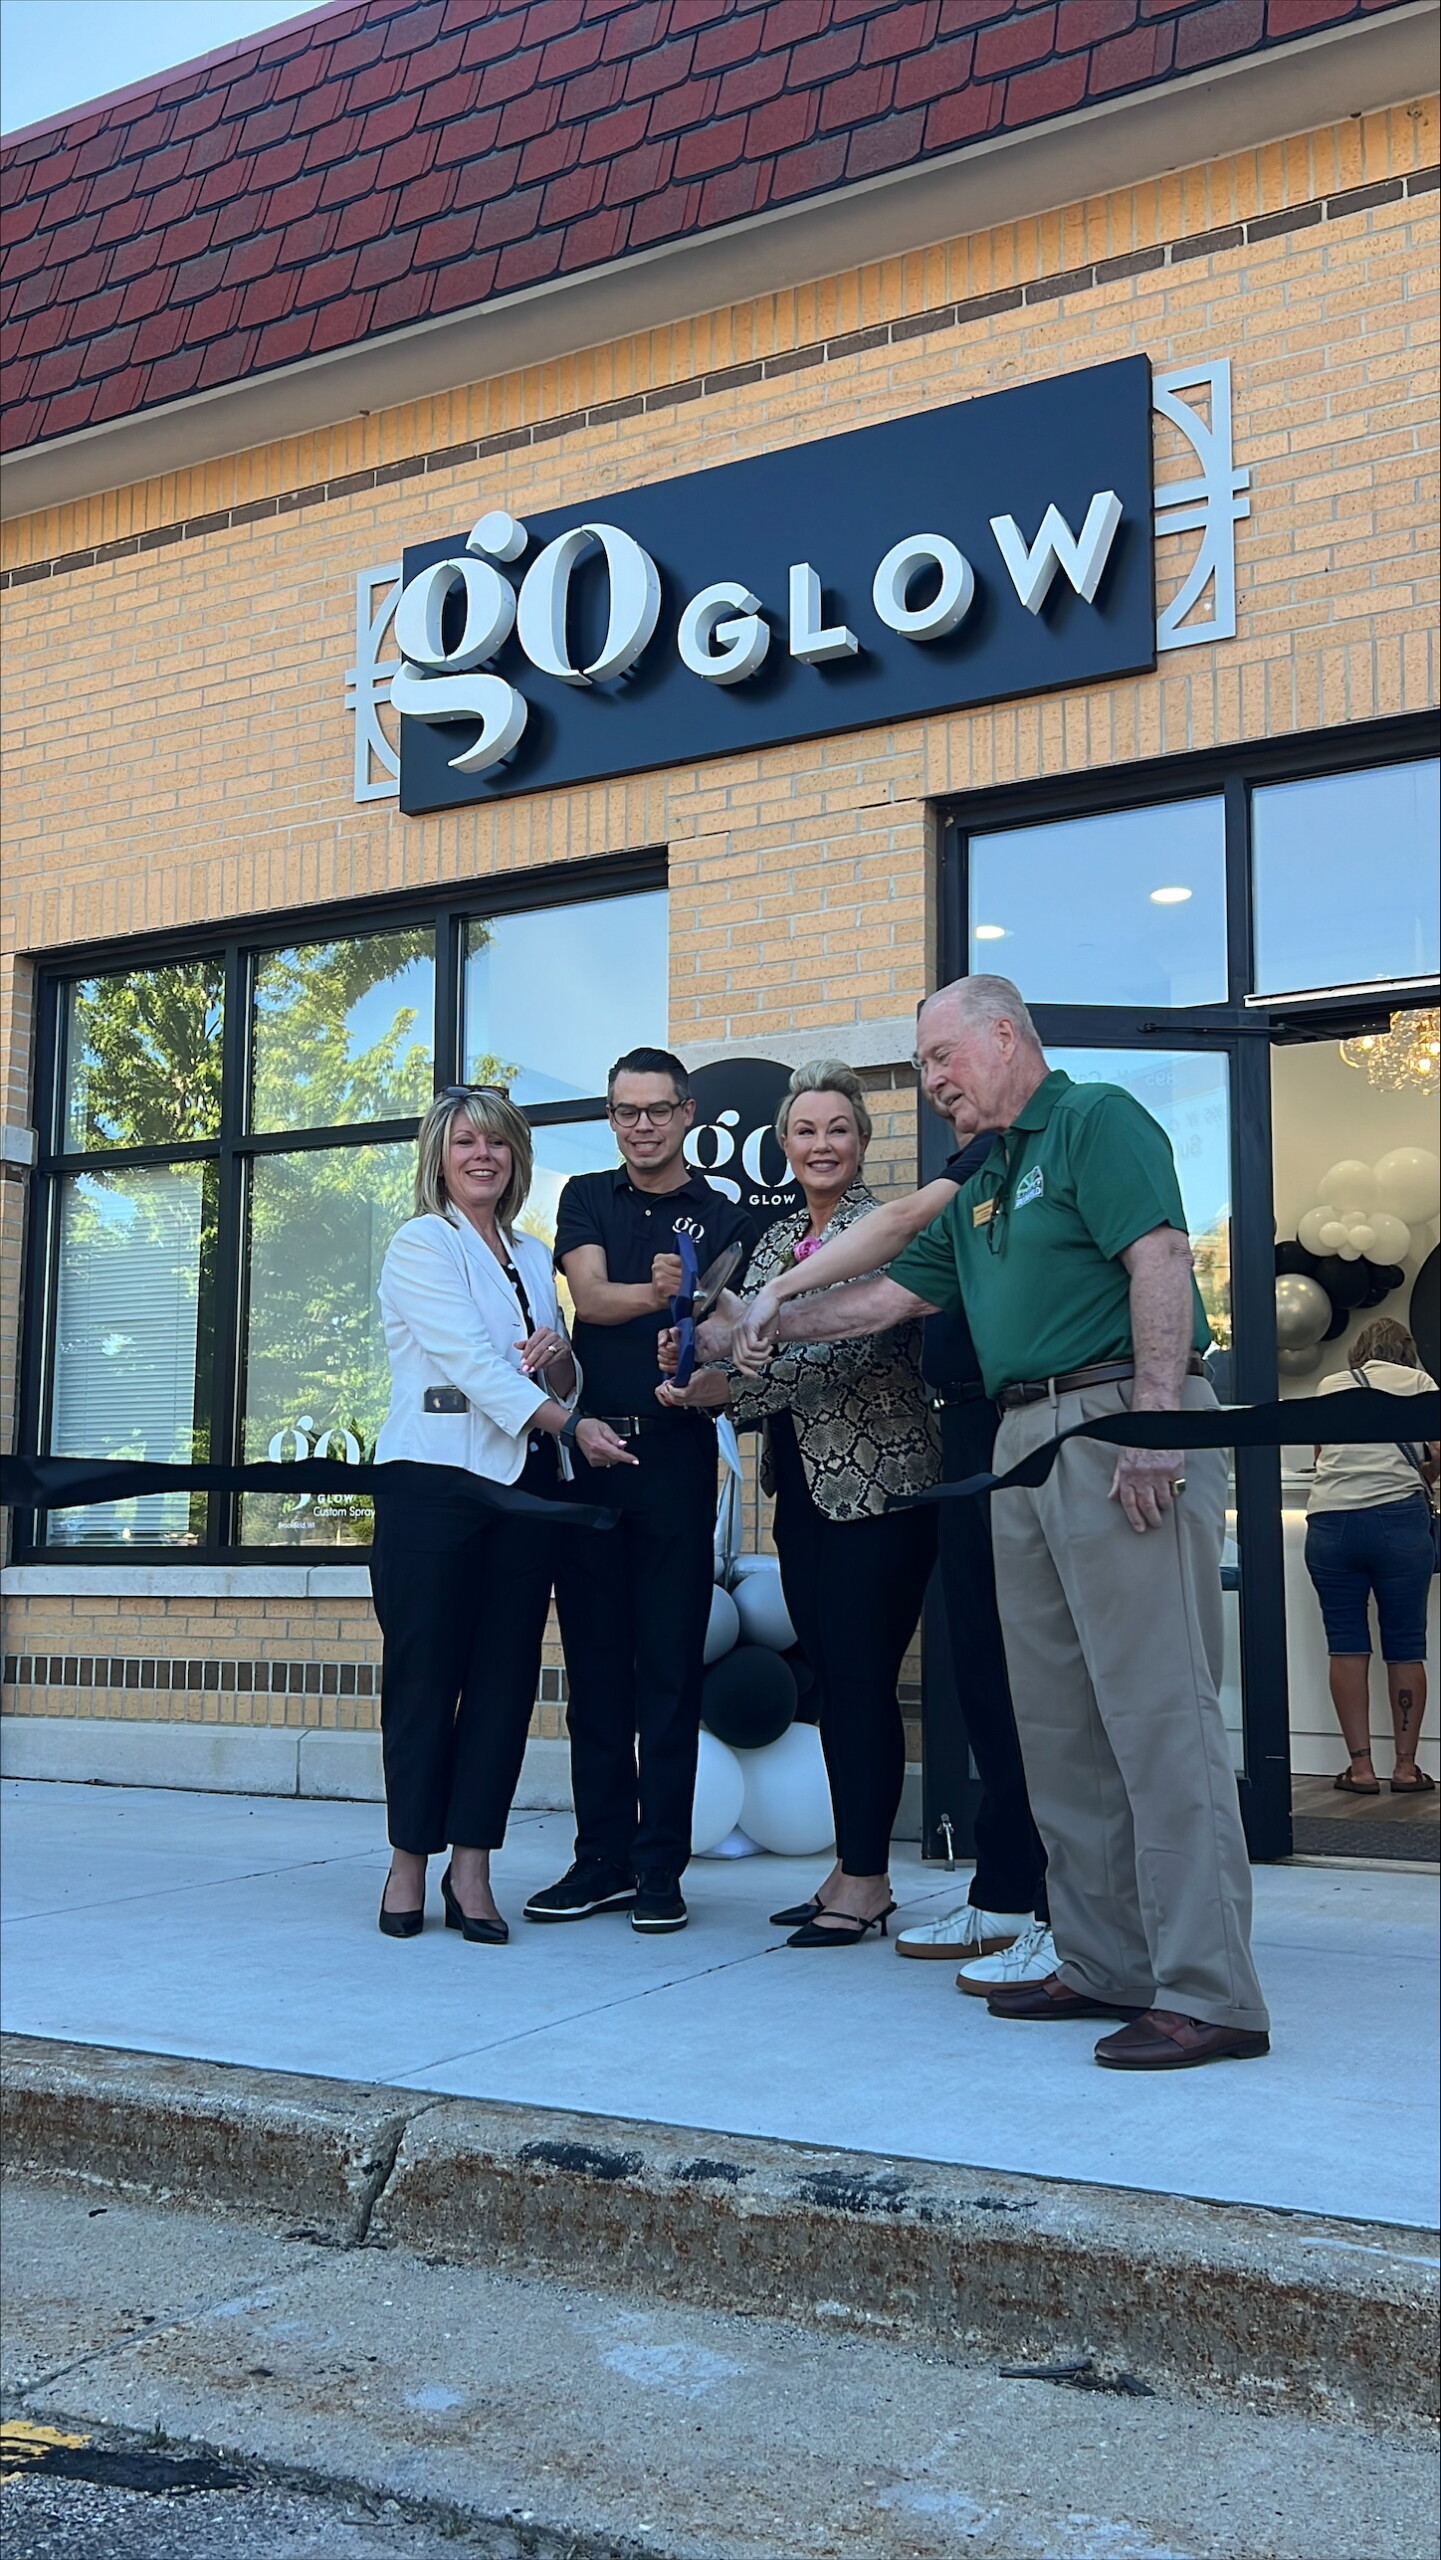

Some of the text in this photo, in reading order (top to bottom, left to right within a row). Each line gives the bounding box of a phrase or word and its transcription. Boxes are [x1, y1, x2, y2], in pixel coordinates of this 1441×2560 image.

[390, 490, 1123, 773] go GLOW
[749, 1194, 796, 1205] GLOW
[317, 1494, 354, 1504] GLOW
[313, 1507, 375, 1520] Custom Spray
